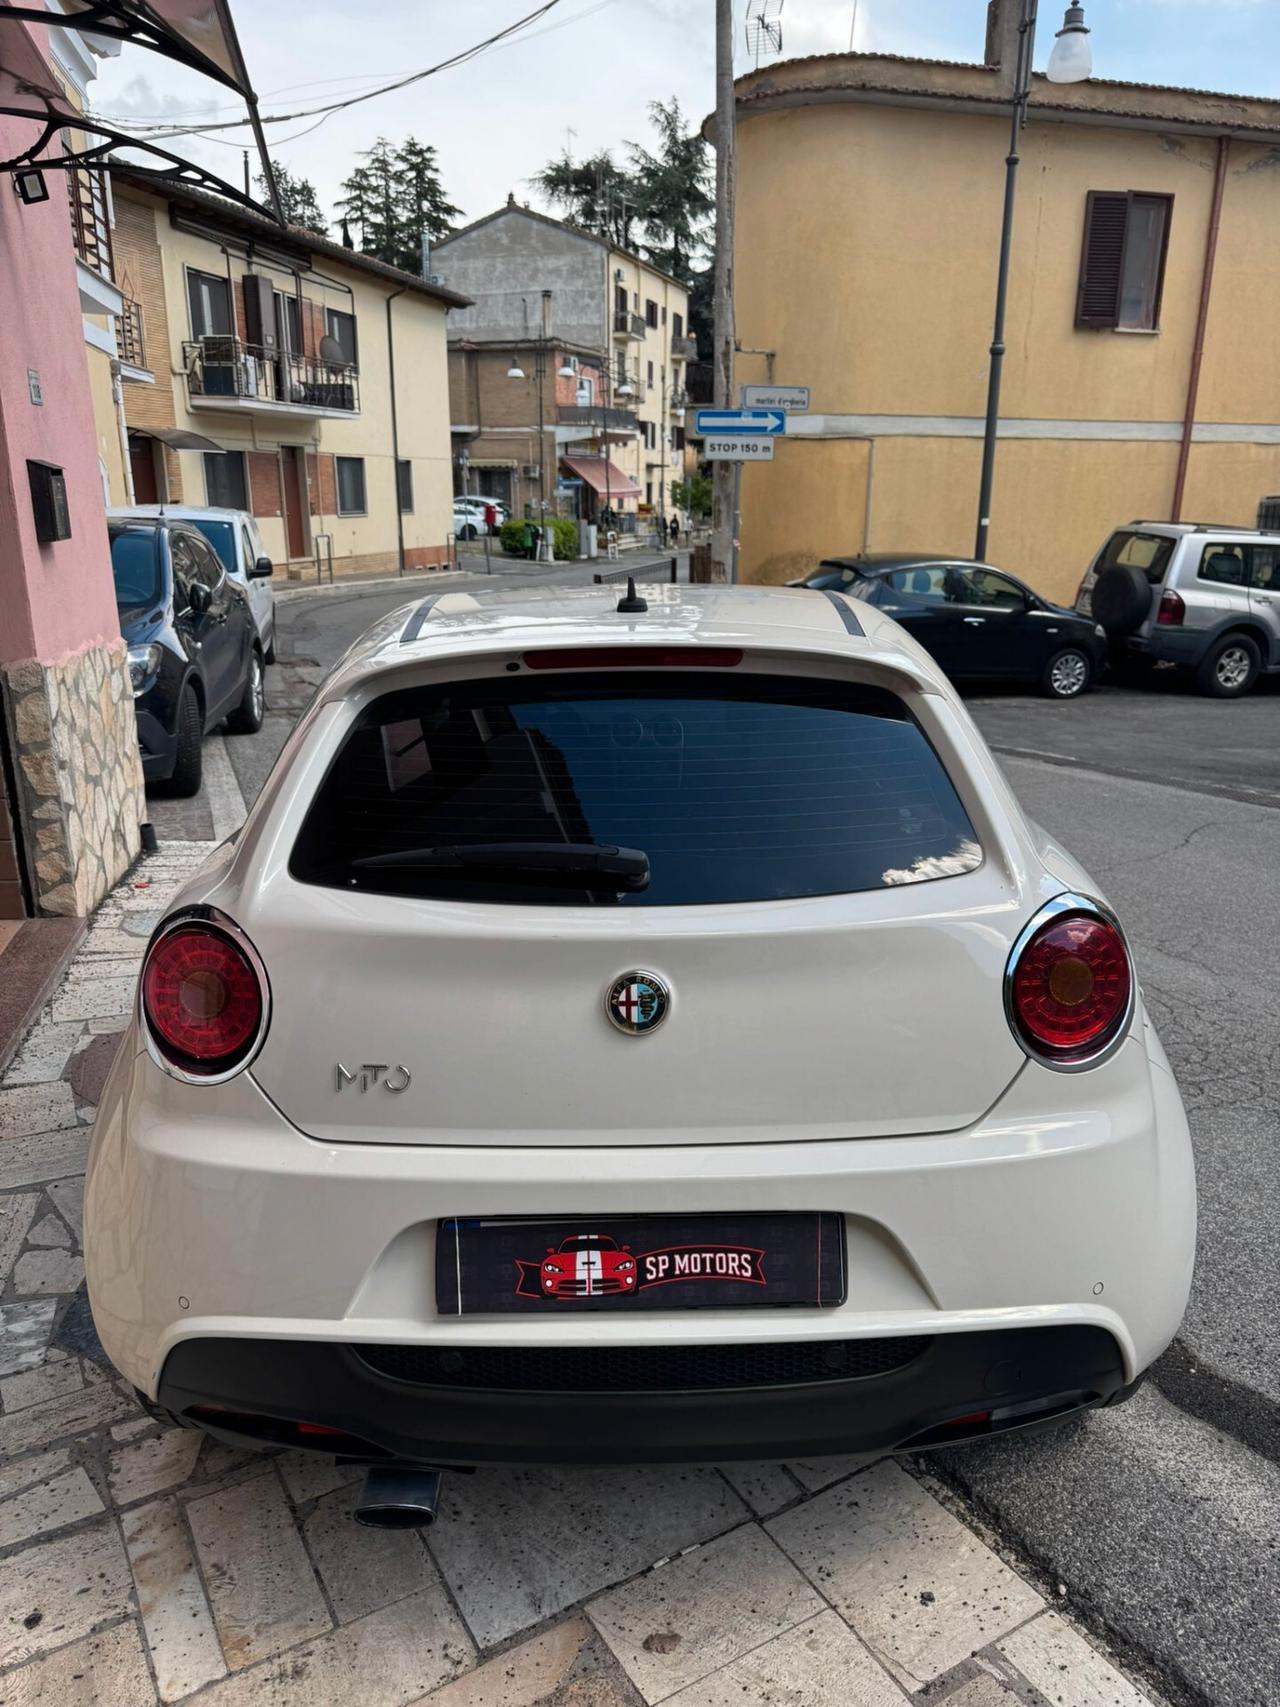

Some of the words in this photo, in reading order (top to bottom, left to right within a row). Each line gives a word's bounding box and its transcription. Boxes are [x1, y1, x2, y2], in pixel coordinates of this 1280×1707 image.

[709, 443, 737, 453] STOP
[740, 443, 758, 453] 150
[761, 445, 771, 453] m
[611, 980, 629, 1006] ALFA
[635, 976, 665, 1004] ROMEO
[645, 1254, 669, 1280] SP
[673, 1252, 752, 1278] MOTORS
